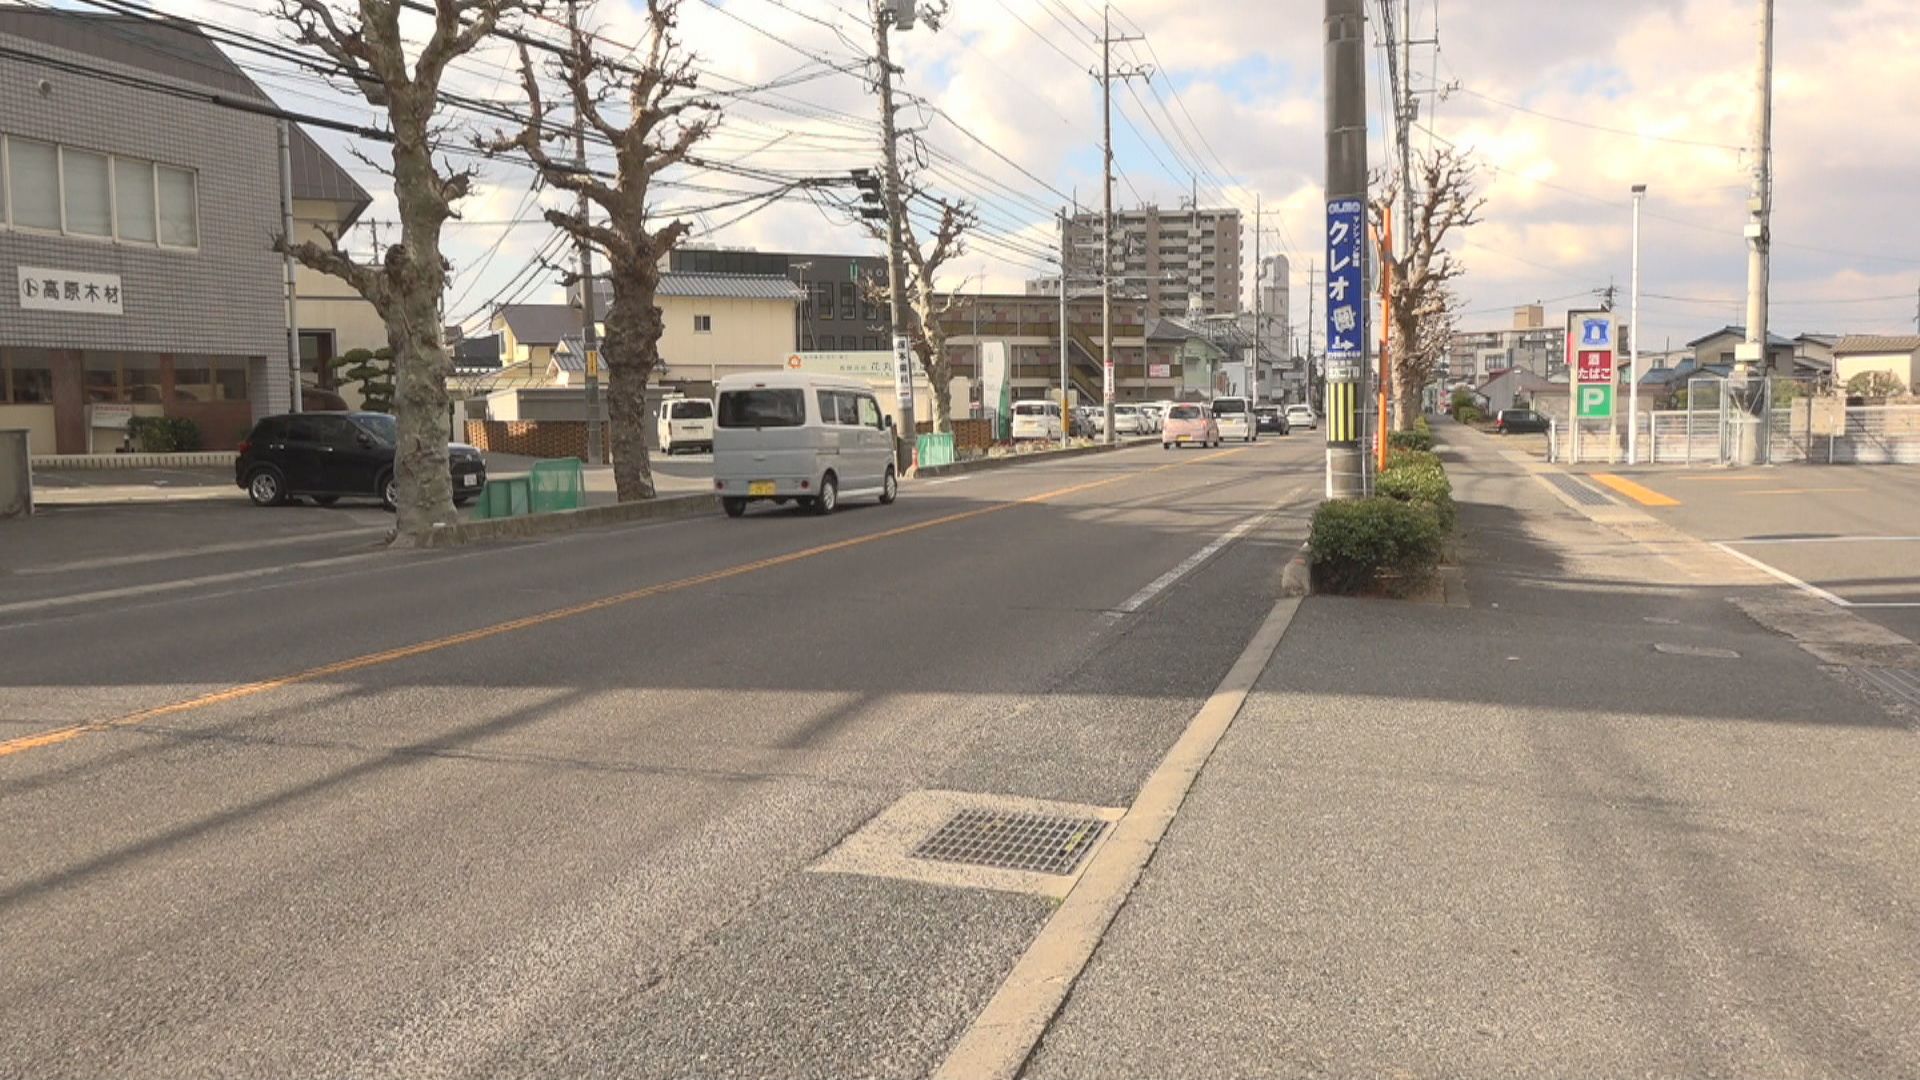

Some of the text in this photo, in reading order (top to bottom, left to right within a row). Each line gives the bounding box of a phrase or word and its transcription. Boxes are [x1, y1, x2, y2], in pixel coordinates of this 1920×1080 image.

[42, 279, 119, 304] 高原木材
[1578, 367, 1611, 380] たばこ
[1583, 388, 1605, 414] P
